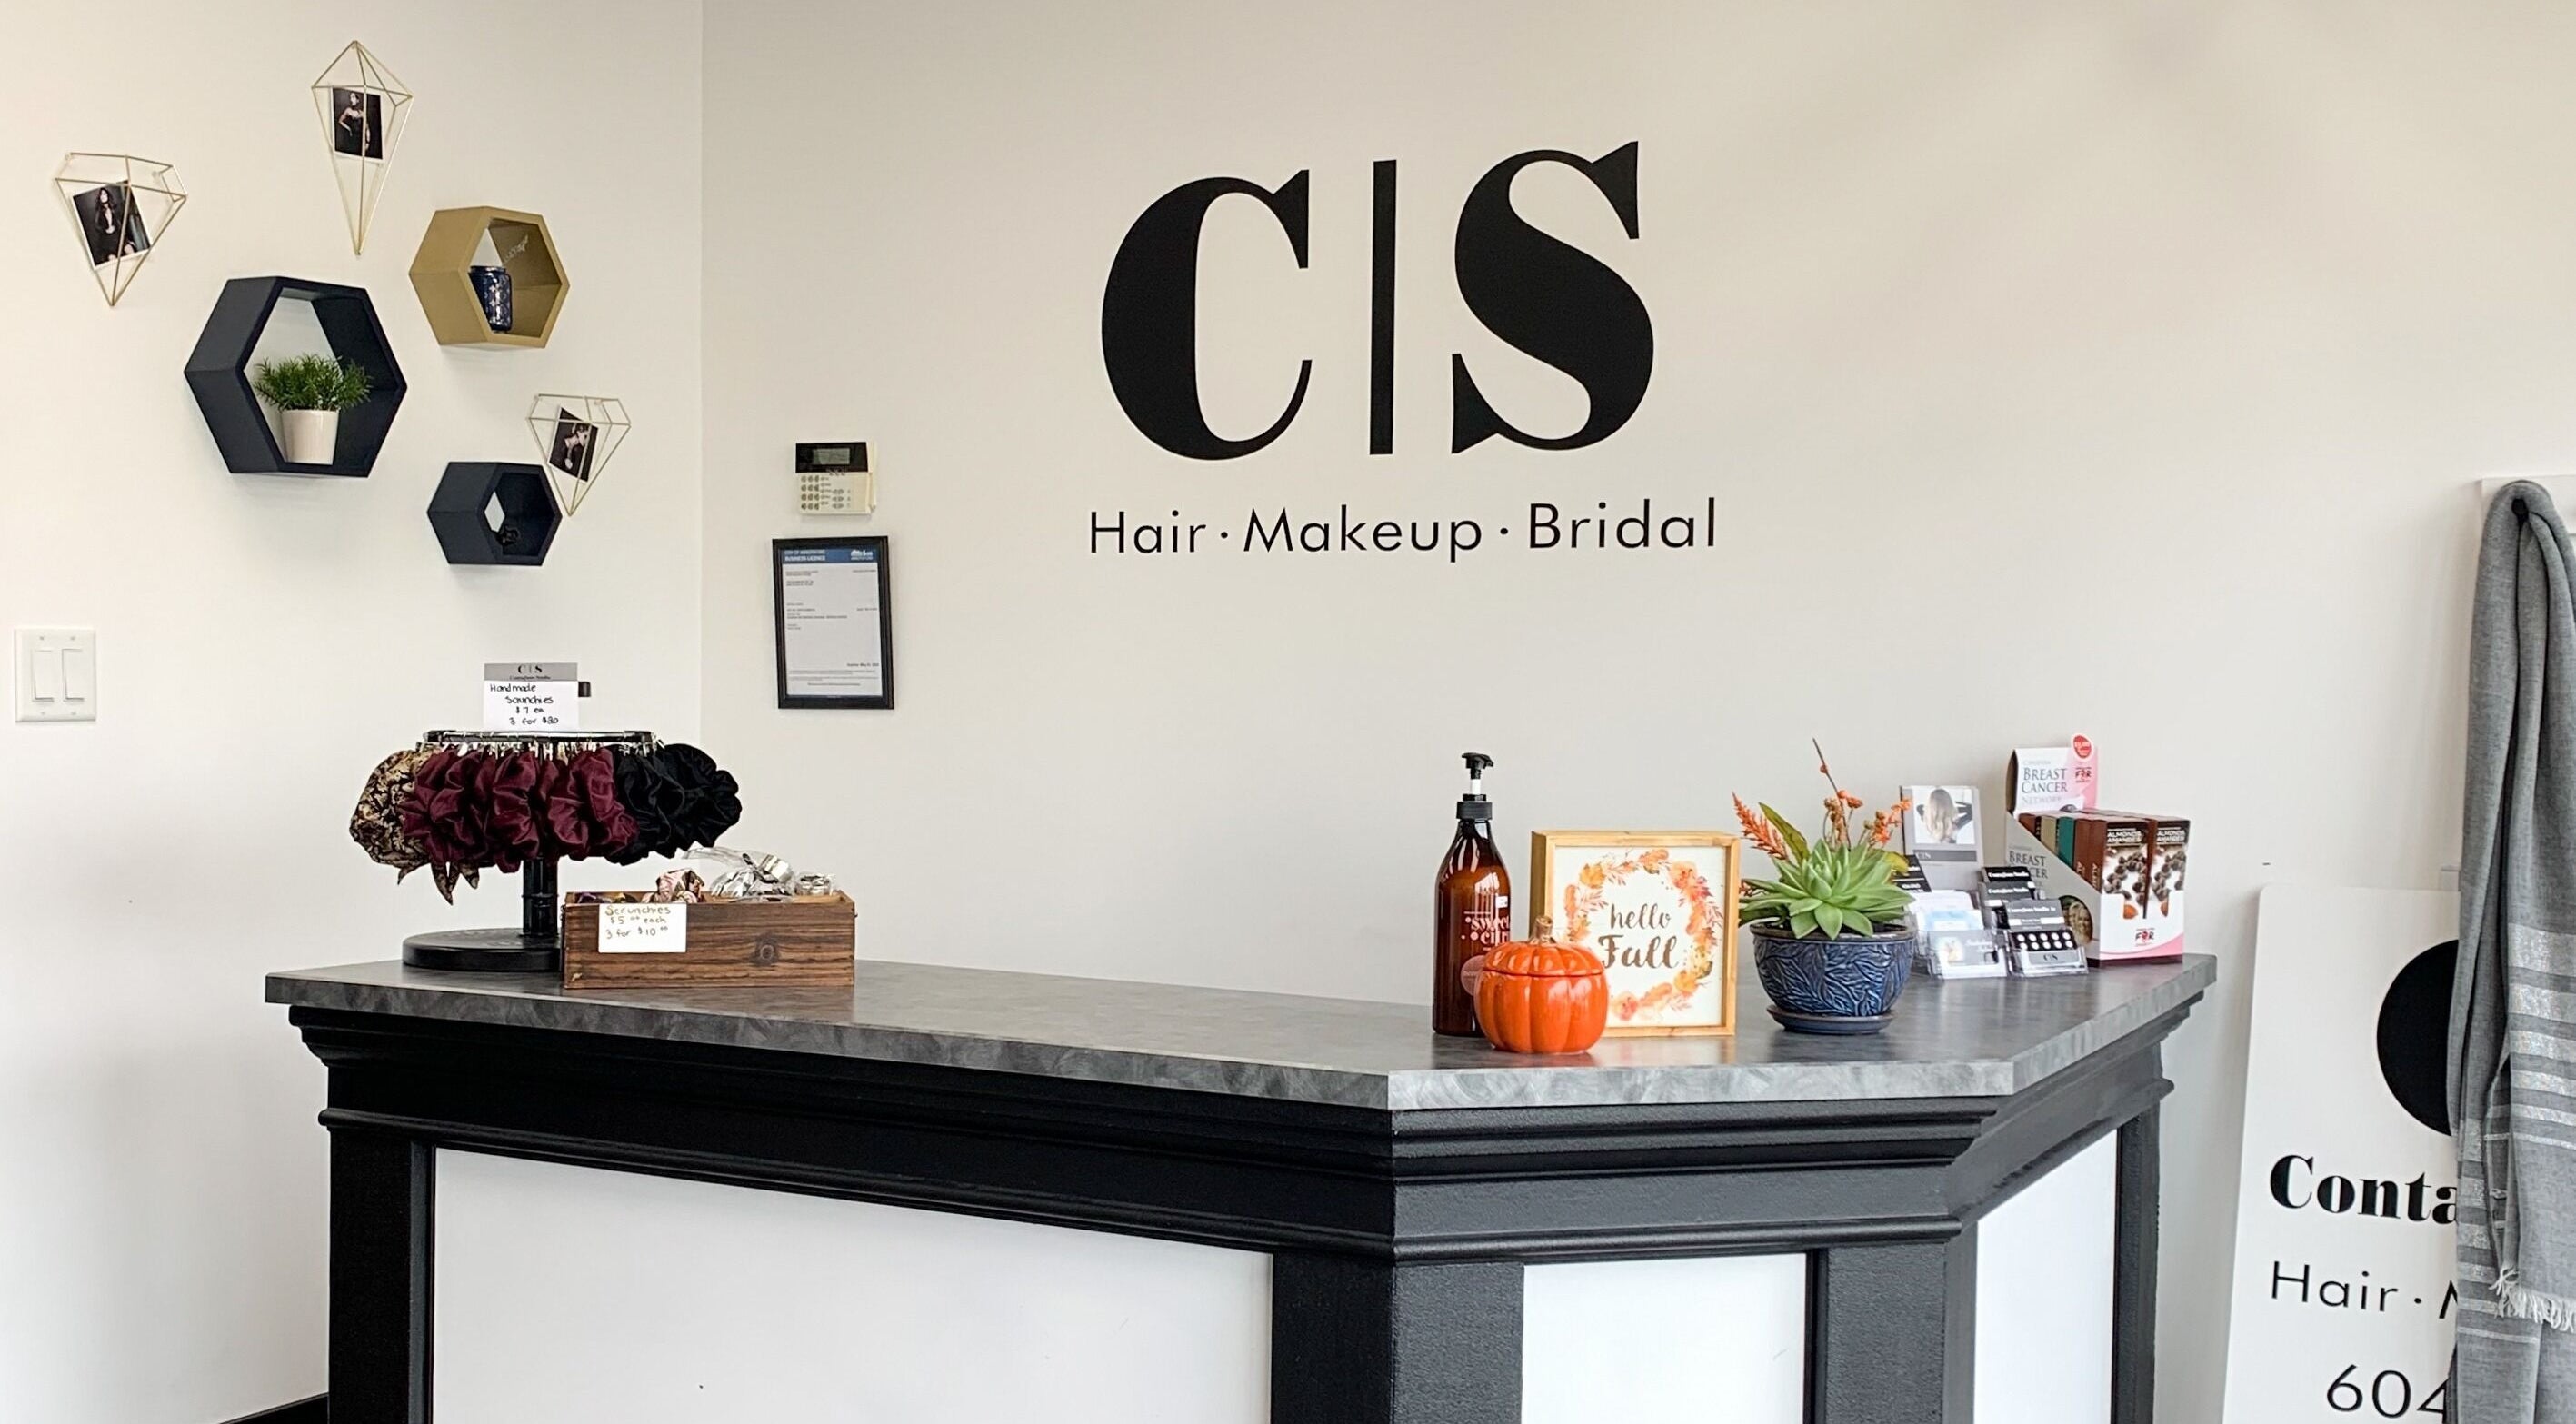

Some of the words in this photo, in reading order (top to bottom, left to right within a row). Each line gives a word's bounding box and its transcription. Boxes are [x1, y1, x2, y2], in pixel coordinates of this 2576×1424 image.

[1090, 510, 1206, 553] Hair
[1243, 504, 1483, 563] Makeup
[1529, 497, 1716, 549] Bridal
[522, 717, 536, 725] for
[2023, 767, 2068, 781] BREAST
[2022, 781, 2068, 793] CANCER
[2009, 851, 2046, 867] BREAST
[604, 905, 671, 916] Scrunchies
[1610, 902, 1671, 929] hello
[644, 916, 666, 924] each
[605, 929, 613, 940] 3
[616, 929, 632, 938] for
[1597, 934, 1679, 970] Fall
[2271, 1260, 2400, 1312] Hair
